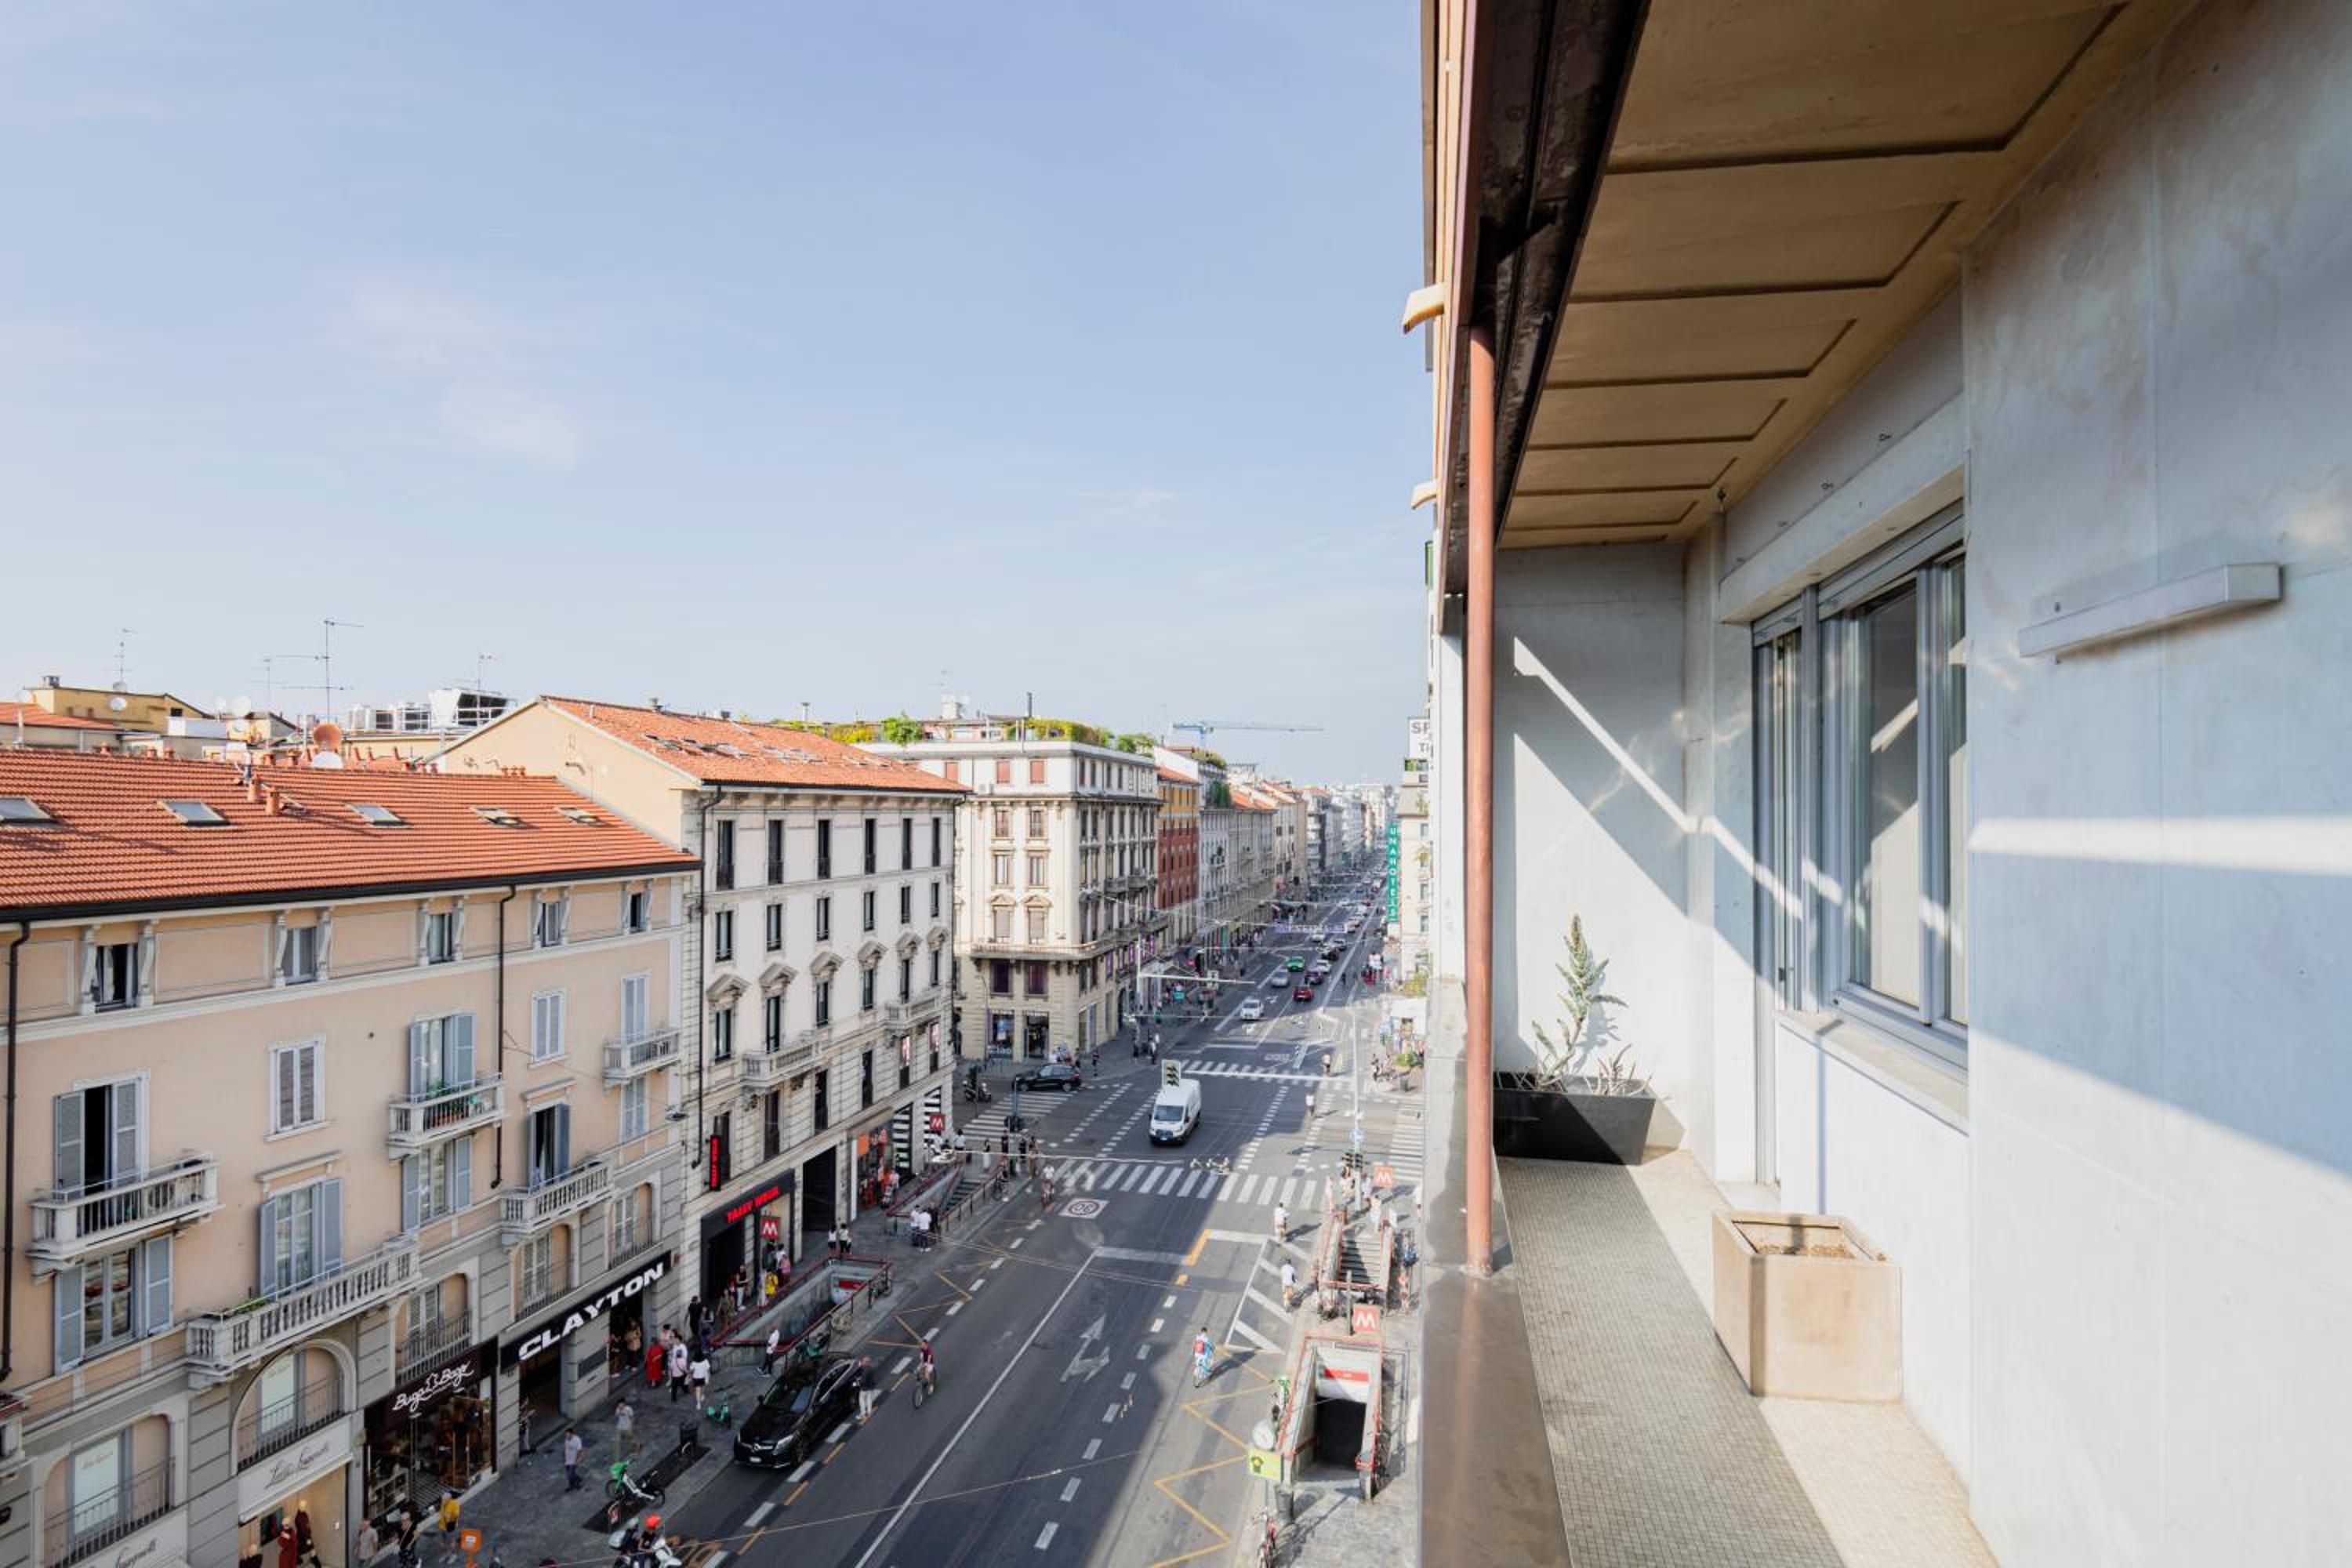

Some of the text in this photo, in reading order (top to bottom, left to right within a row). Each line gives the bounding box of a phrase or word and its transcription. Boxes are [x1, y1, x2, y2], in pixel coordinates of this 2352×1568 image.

[763, 1221, 778, 1236] M
[518, 1262, 664, 1361] CLAYTON
[1356, 1310, 1377, 1330] M
